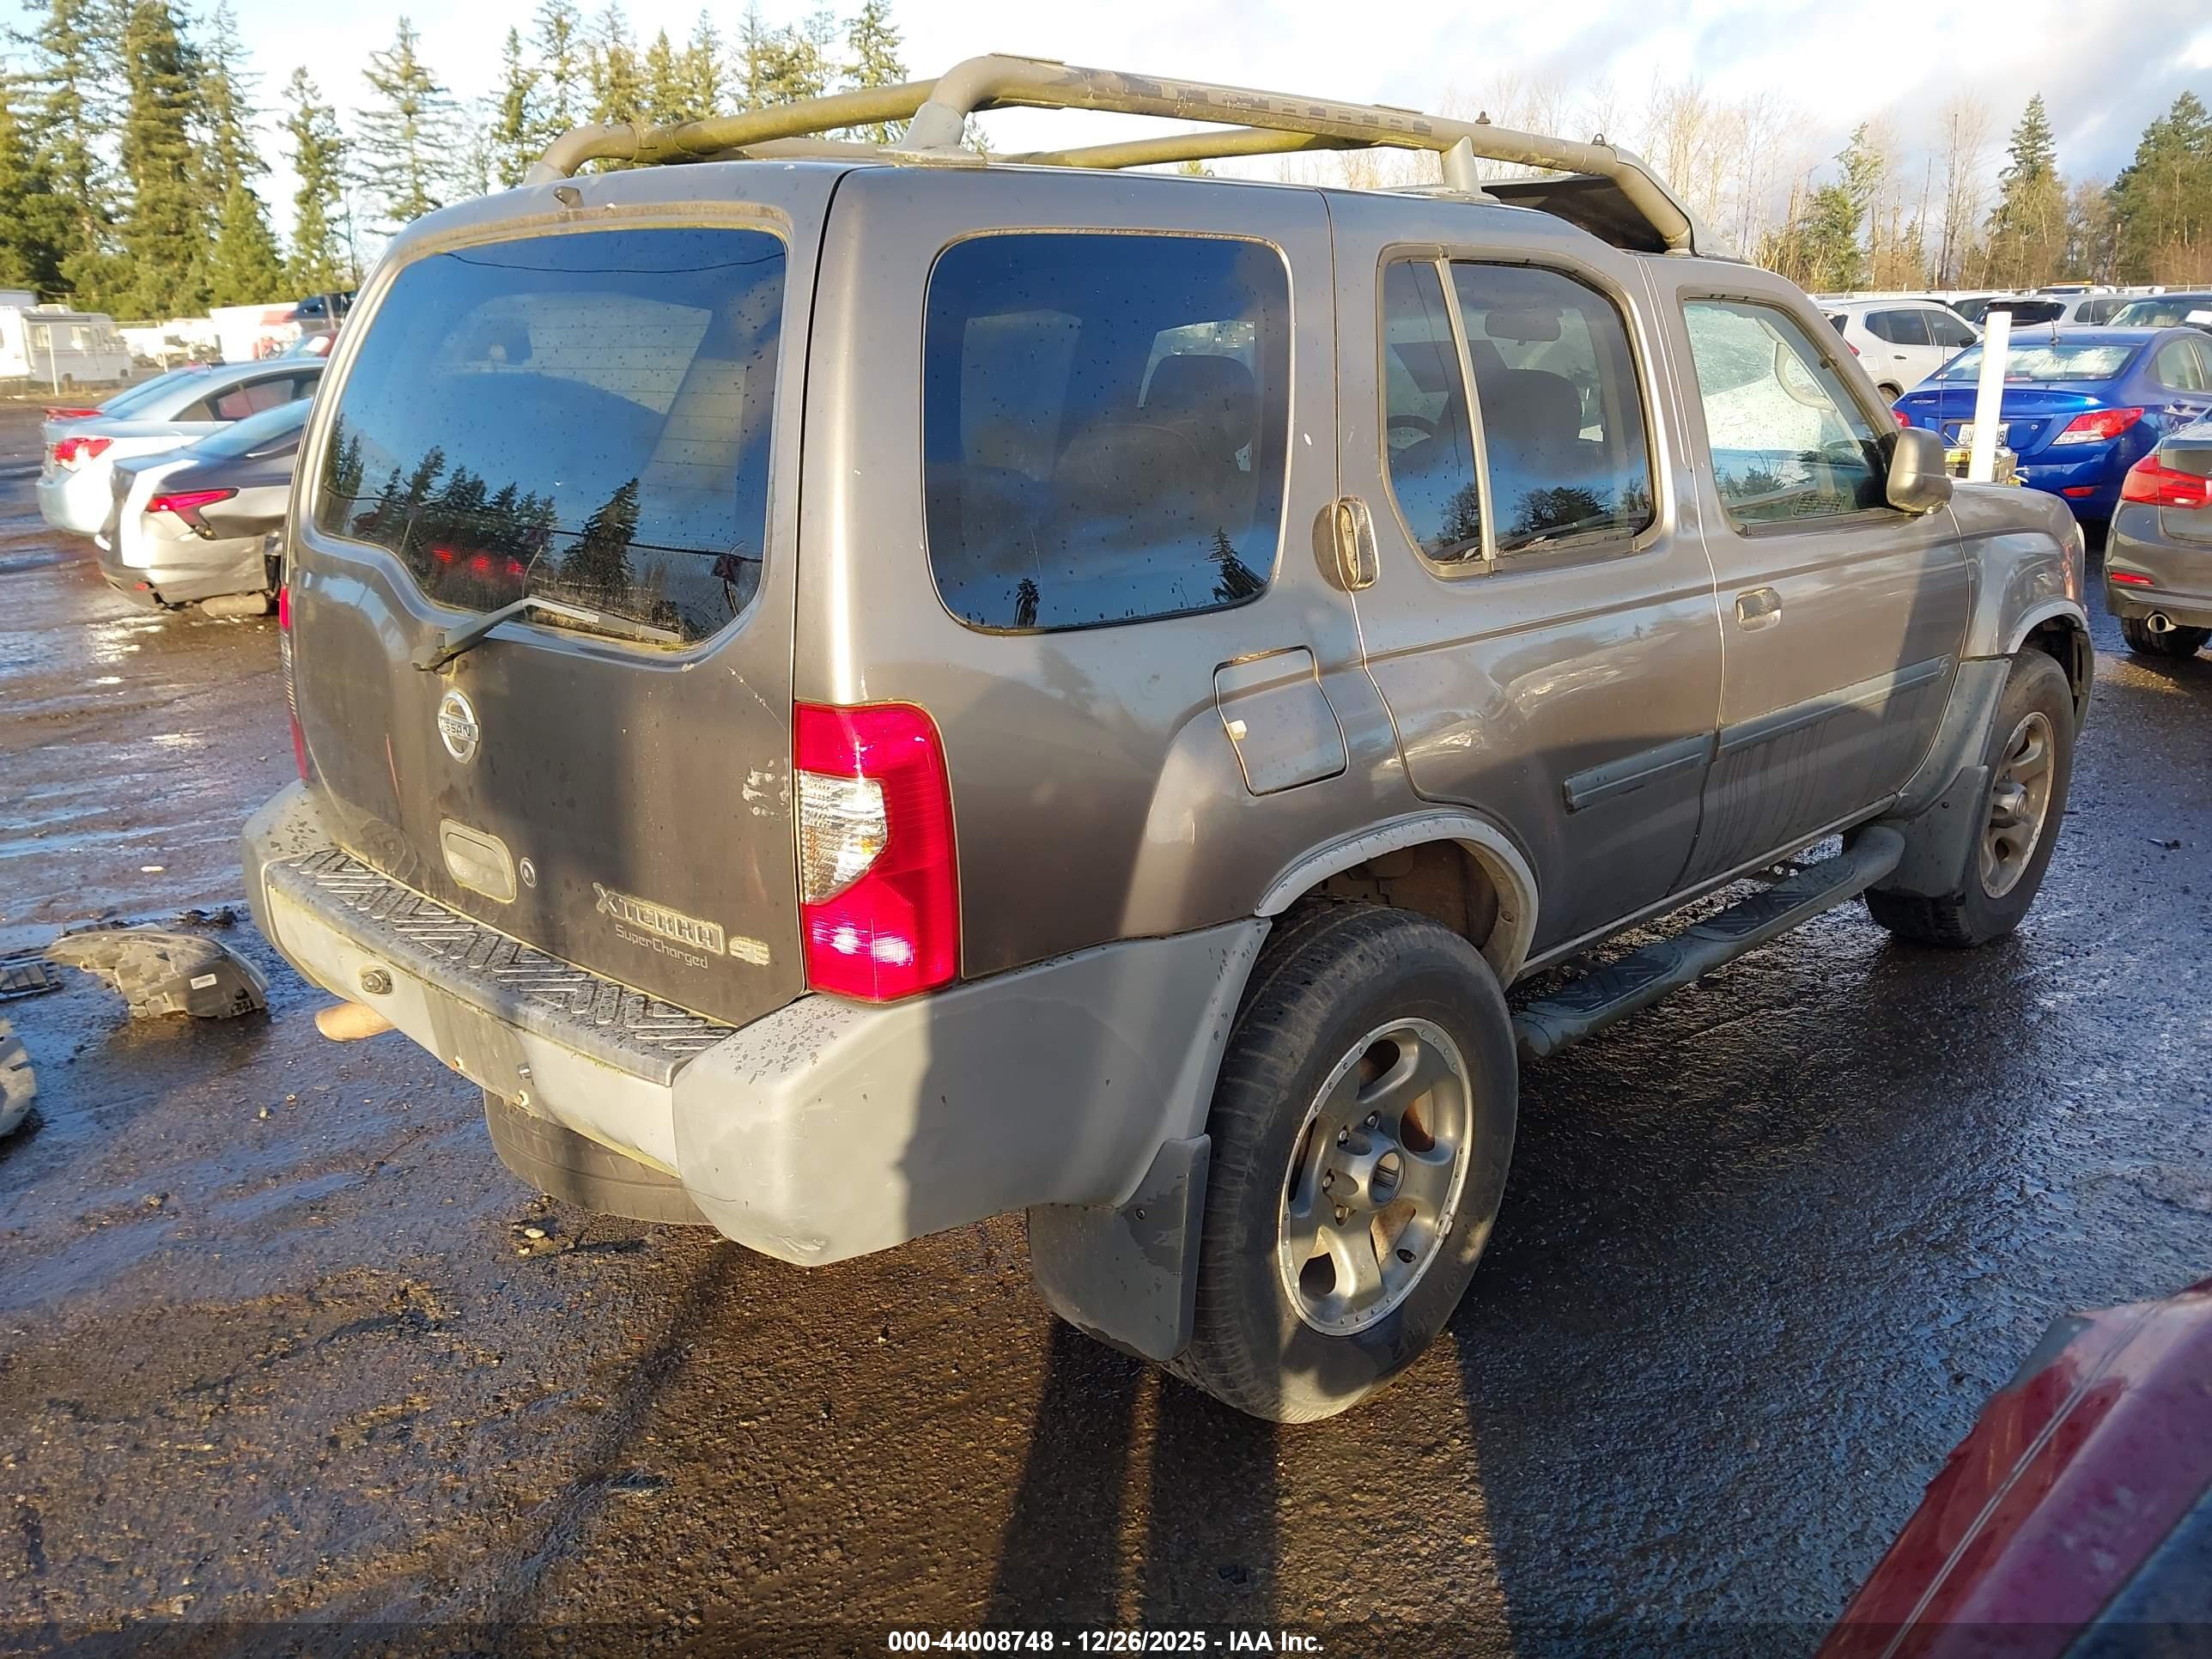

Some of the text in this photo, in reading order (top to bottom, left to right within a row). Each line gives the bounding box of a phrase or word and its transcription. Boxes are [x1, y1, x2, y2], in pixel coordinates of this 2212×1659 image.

[439, 716, 471, 737] NISSAN
[592, 882, 771, 967] XTERRA SE
[615, 923, 708, 969] SuperCharged
